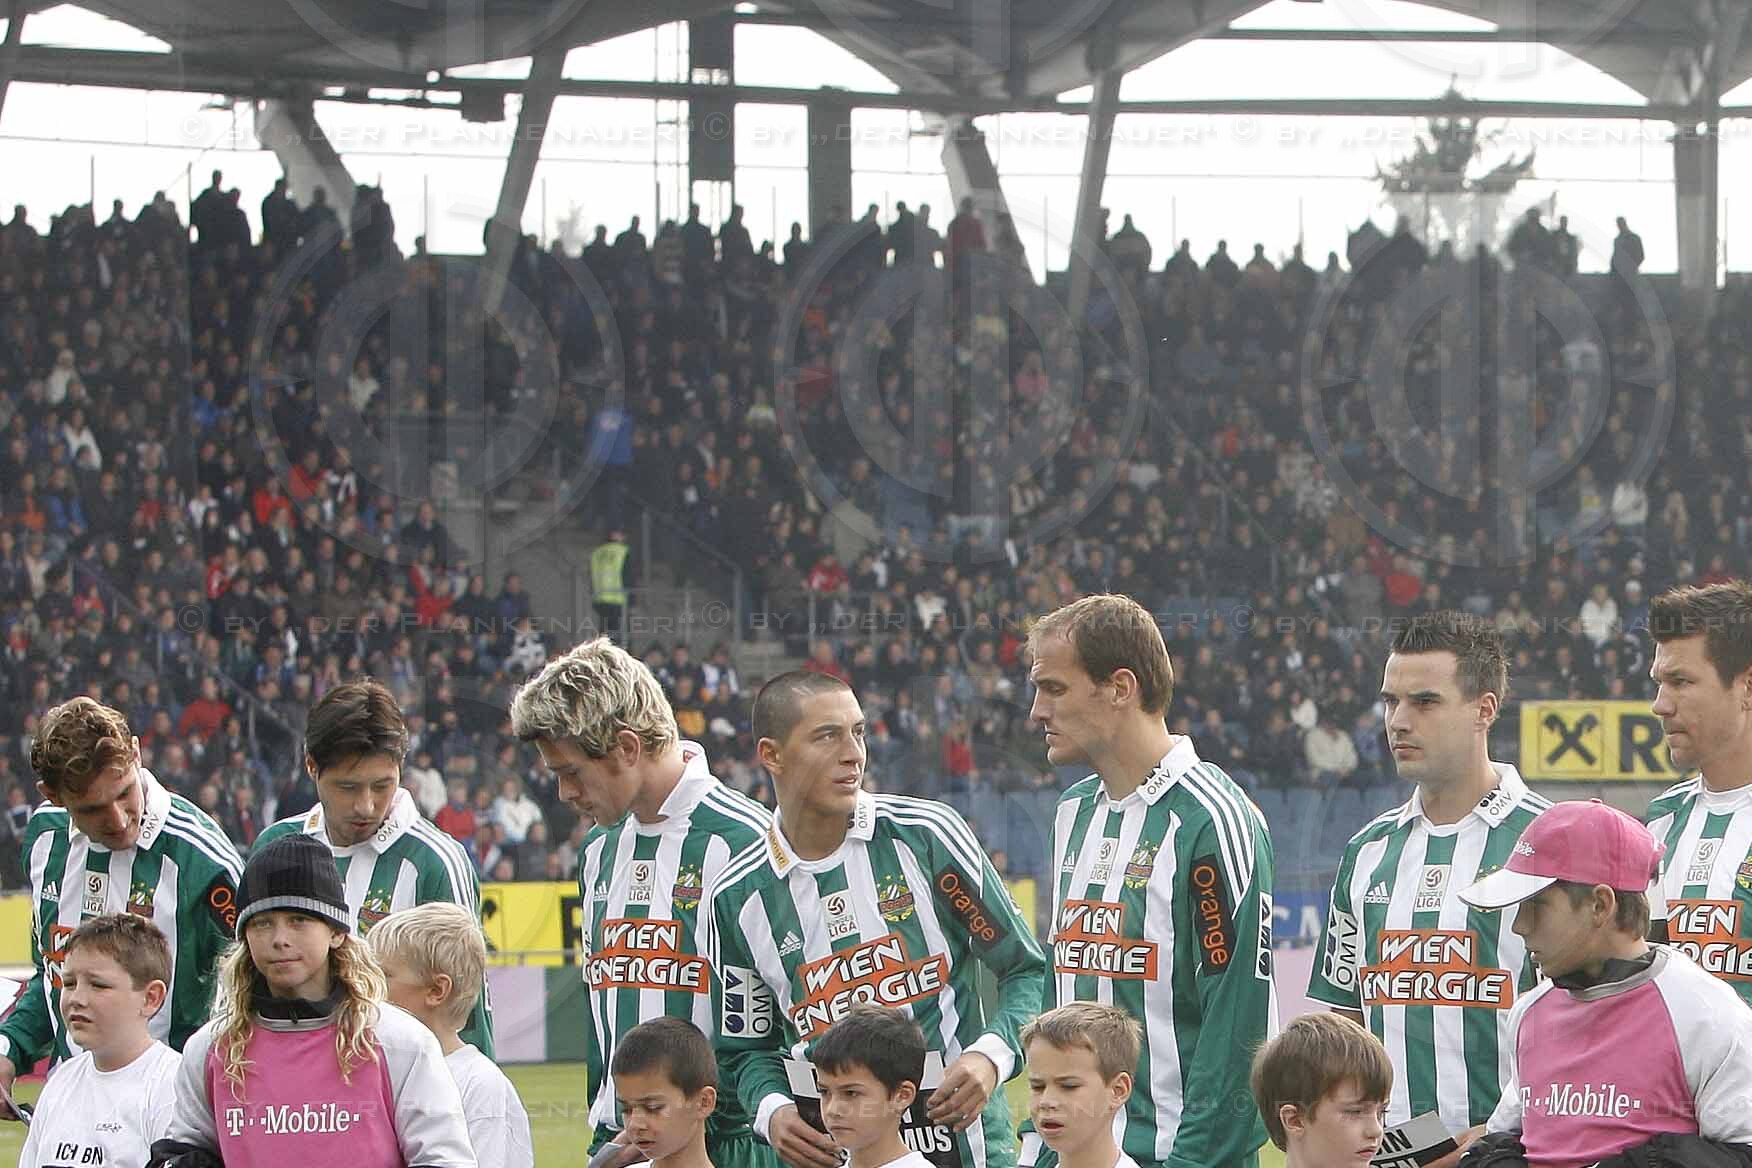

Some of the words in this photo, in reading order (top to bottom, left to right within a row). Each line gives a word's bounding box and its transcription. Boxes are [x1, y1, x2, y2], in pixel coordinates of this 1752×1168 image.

[1148, 771, 1170, 795] OMV
[1489, 792, 1512, 816] OMV
[377, 821, 400, 843] OMV
[630, 890, 650, 901] LIGA
[939, 874, 995, 941] Orange
[1416, 898, 1441, 908] LIGA
[829, 924, 857, 937] LIGA
[1060, 905, 1120, 936] WIEN
[1193, 866, 1227, 966] Orange
[604, 922, 678, 950] WIEN
[1381, 935, 1473, 965] WIEN
[805, 938, 904, 993] WIEN
[1054, 942, 1152, 974] NERGIE
[1336, 918, 1358, 986] OMV
[590, 955, 704, 986] ENERGIE
[751, 974, 772, 1035] OMV
[56, 1142, 79, 1161] ICH
